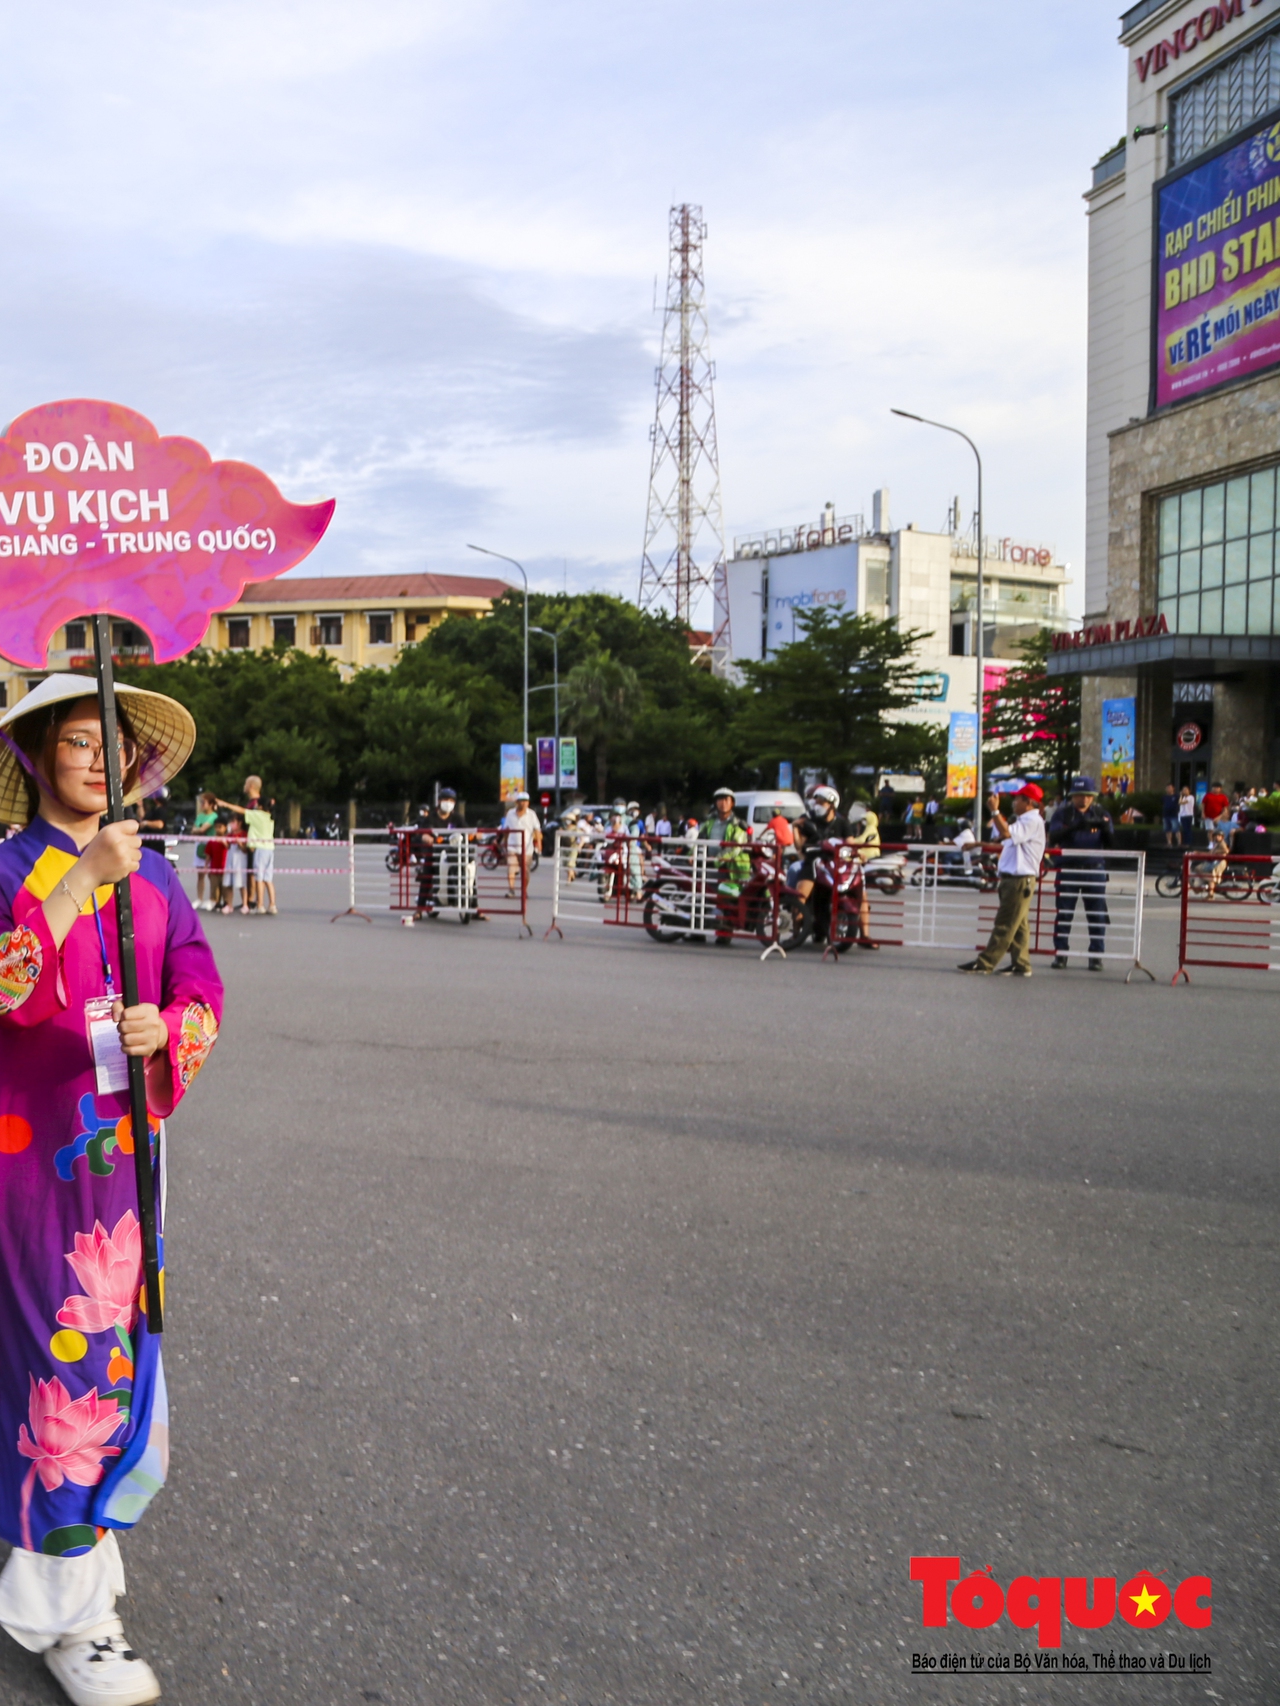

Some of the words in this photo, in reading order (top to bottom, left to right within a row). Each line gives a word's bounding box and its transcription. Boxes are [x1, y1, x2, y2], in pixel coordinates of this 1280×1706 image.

[1134, 0, 1245, 83] VINCOM
[1165, 222, 1193, 259] RẠP
[1197, 189, 1242, 243] CHIẾU
[1165, 251, 1216, 311] BHD
[23, 434, 135, 473] ĐOÀN
[67, 488, 170, 531] KỊCH
[86, 541, 96, 549] -
[101, 530, 191, 554] TRUNG
[197, 523, 276, 555] QUỐC)
[775, 588, 847, 609] mobifone
[1051, 623, 1111, 651] VINCOM
[1115, 613, 1169, 642] PLAZA
